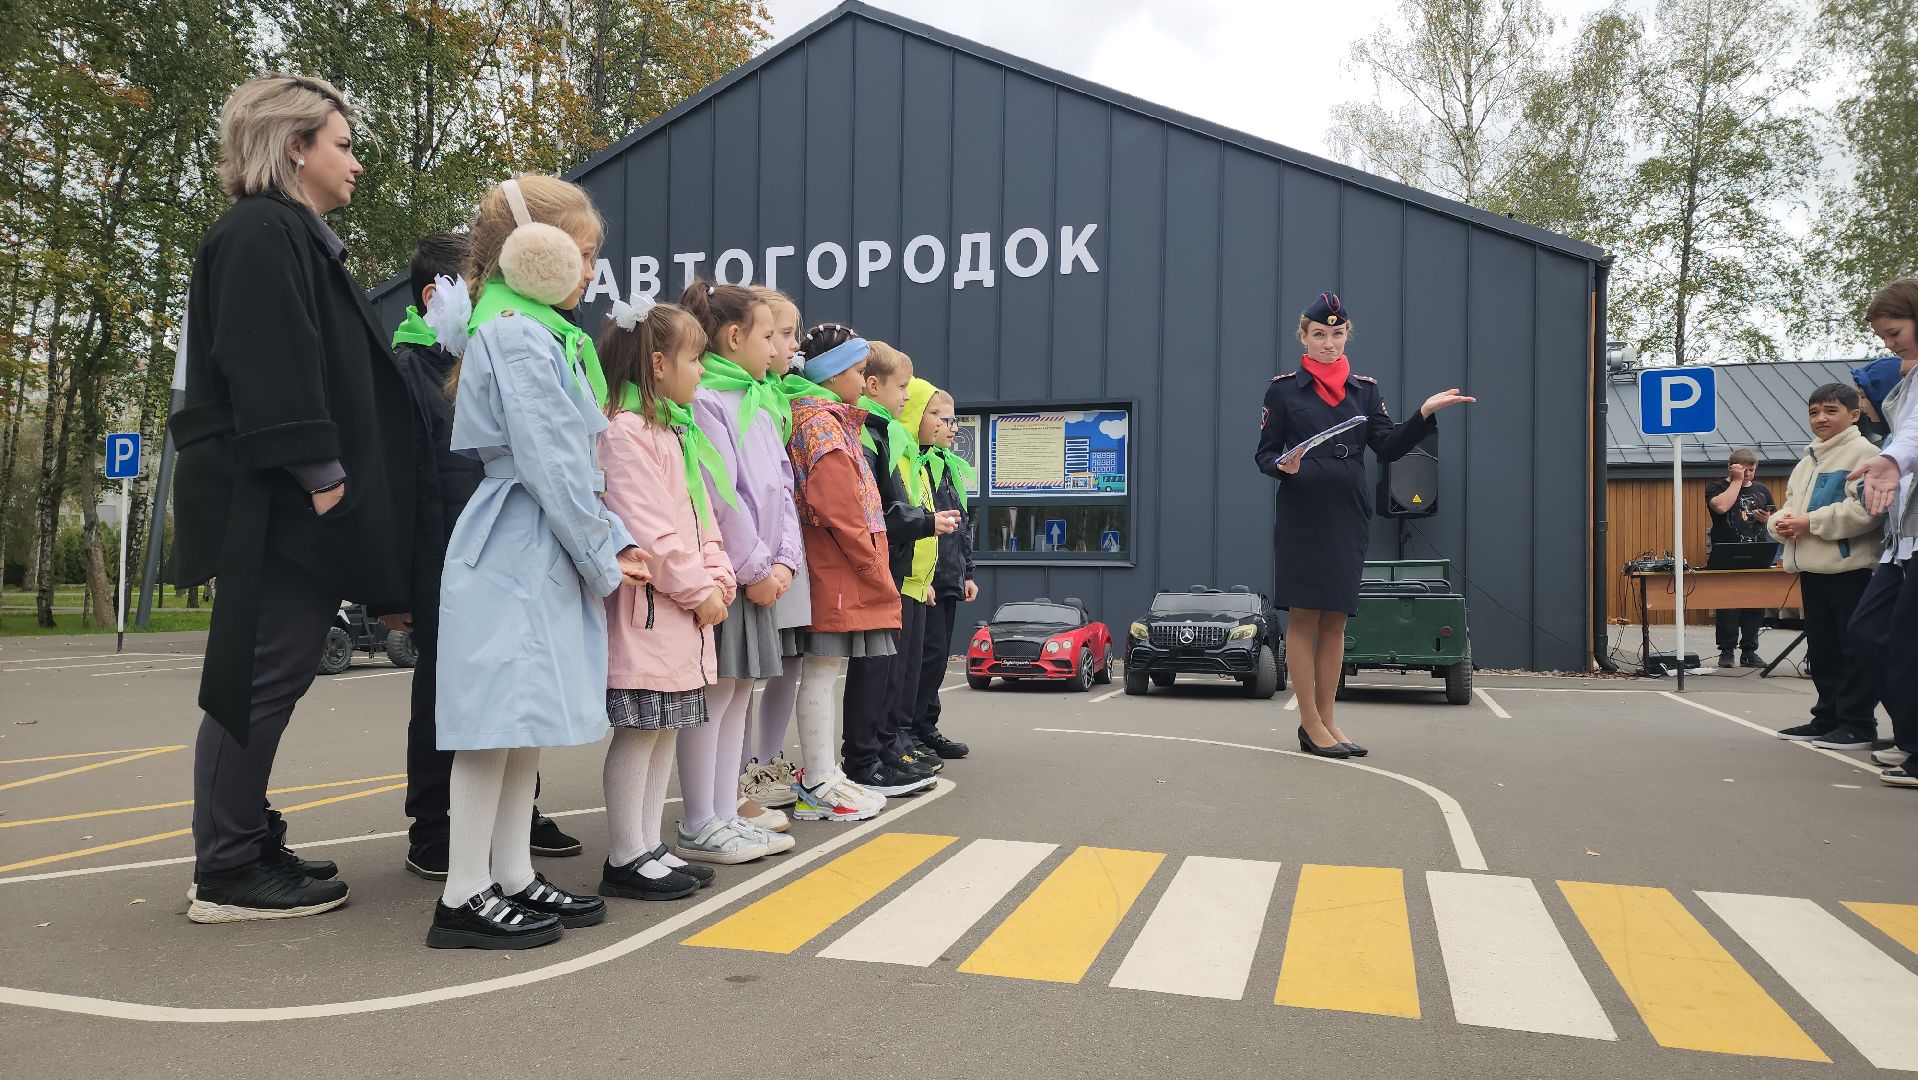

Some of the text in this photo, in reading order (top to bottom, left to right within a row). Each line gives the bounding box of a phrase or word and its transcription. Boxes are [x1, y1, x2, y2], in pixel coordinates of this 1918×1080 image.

[584, 223, 1100, 303] АВТОГОРОДОК
[1661, 376, 1702, 427] P
[115, 438, 134, 473] P
